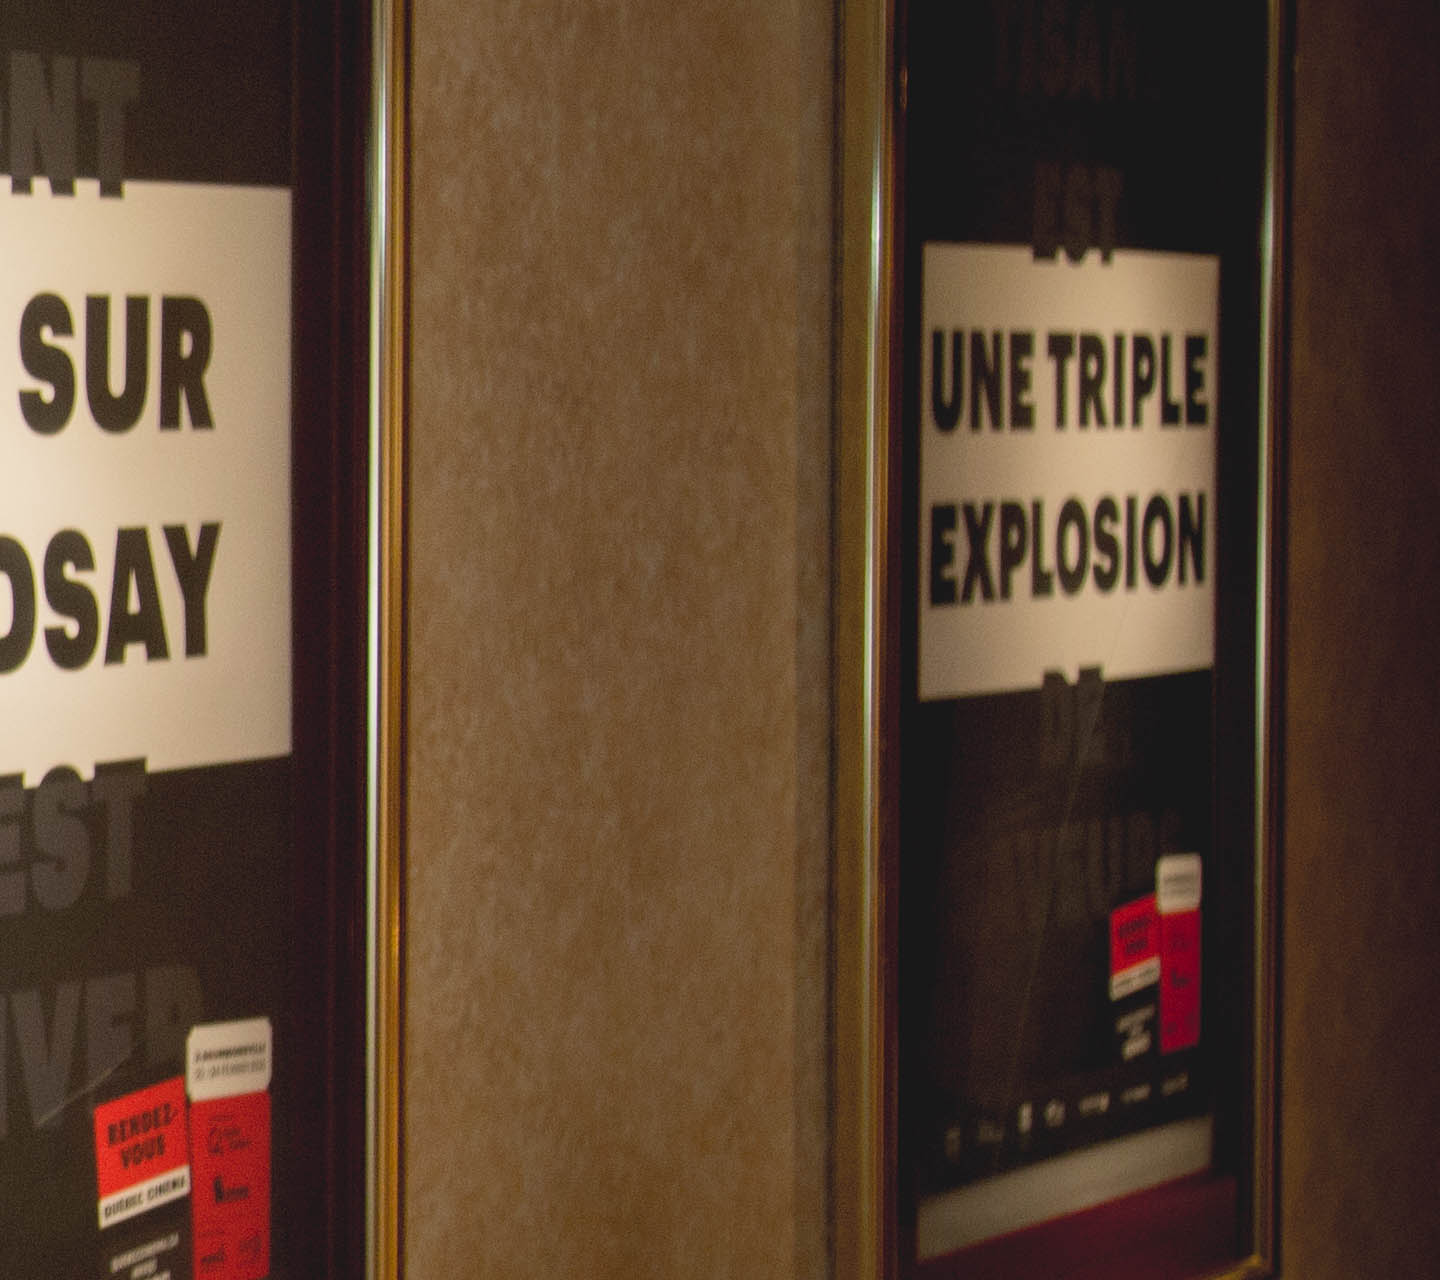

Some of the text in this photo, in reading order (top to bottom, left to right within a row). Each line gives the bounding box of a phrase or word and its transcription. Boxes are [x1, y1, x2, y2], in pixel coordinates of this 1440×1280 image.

[17, 290, 216, 437] SUR
[929, 327, 1210, 435] UNE TRIPLE
[928, 489, 1208, 609] EXPLOSION
